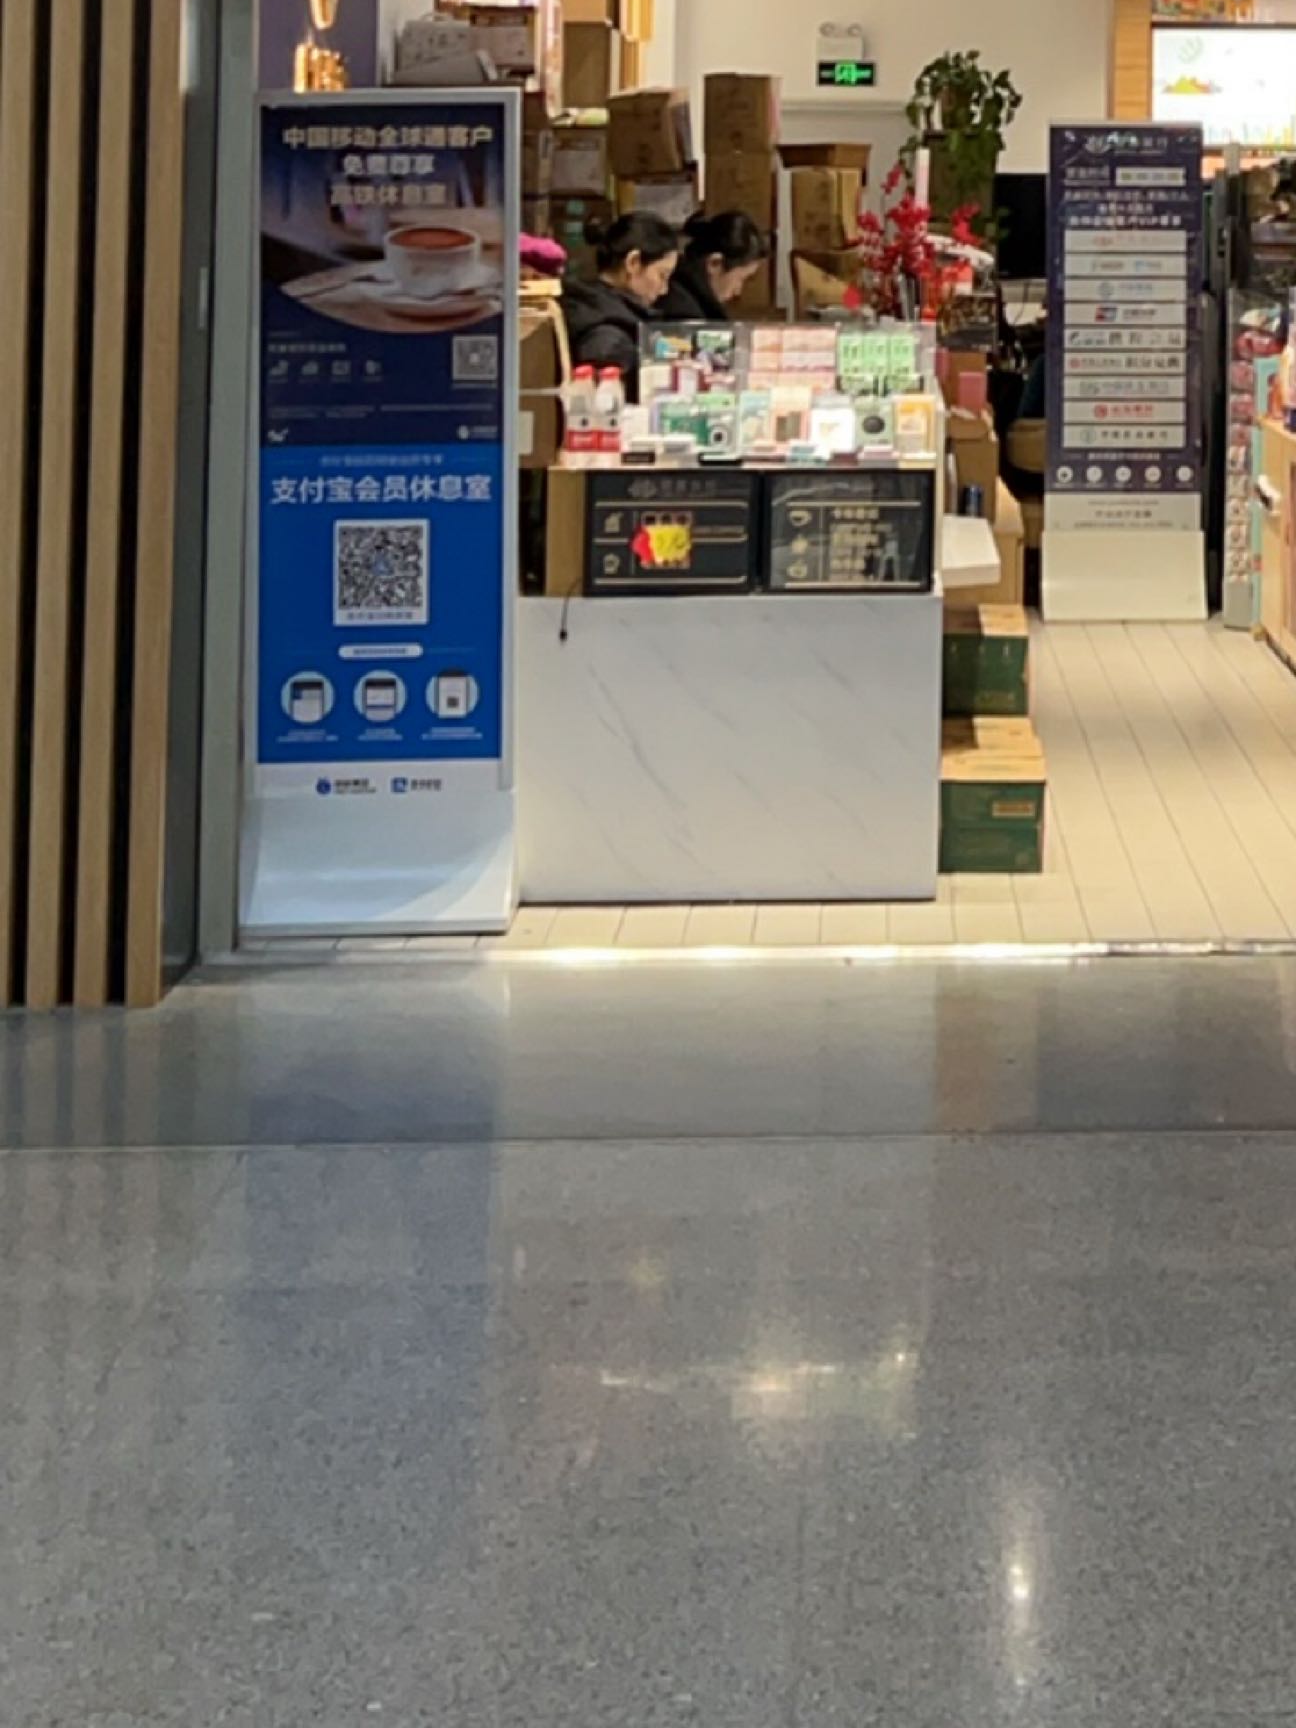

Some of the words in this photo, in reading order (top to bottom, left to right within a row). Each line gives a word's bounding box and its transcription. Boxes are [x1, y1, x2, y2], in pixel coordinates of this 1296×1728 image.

[282, 126, 493, 149] 中国移动全球通客户
[271, 474, 492, 505] 支付宝会员休息室
